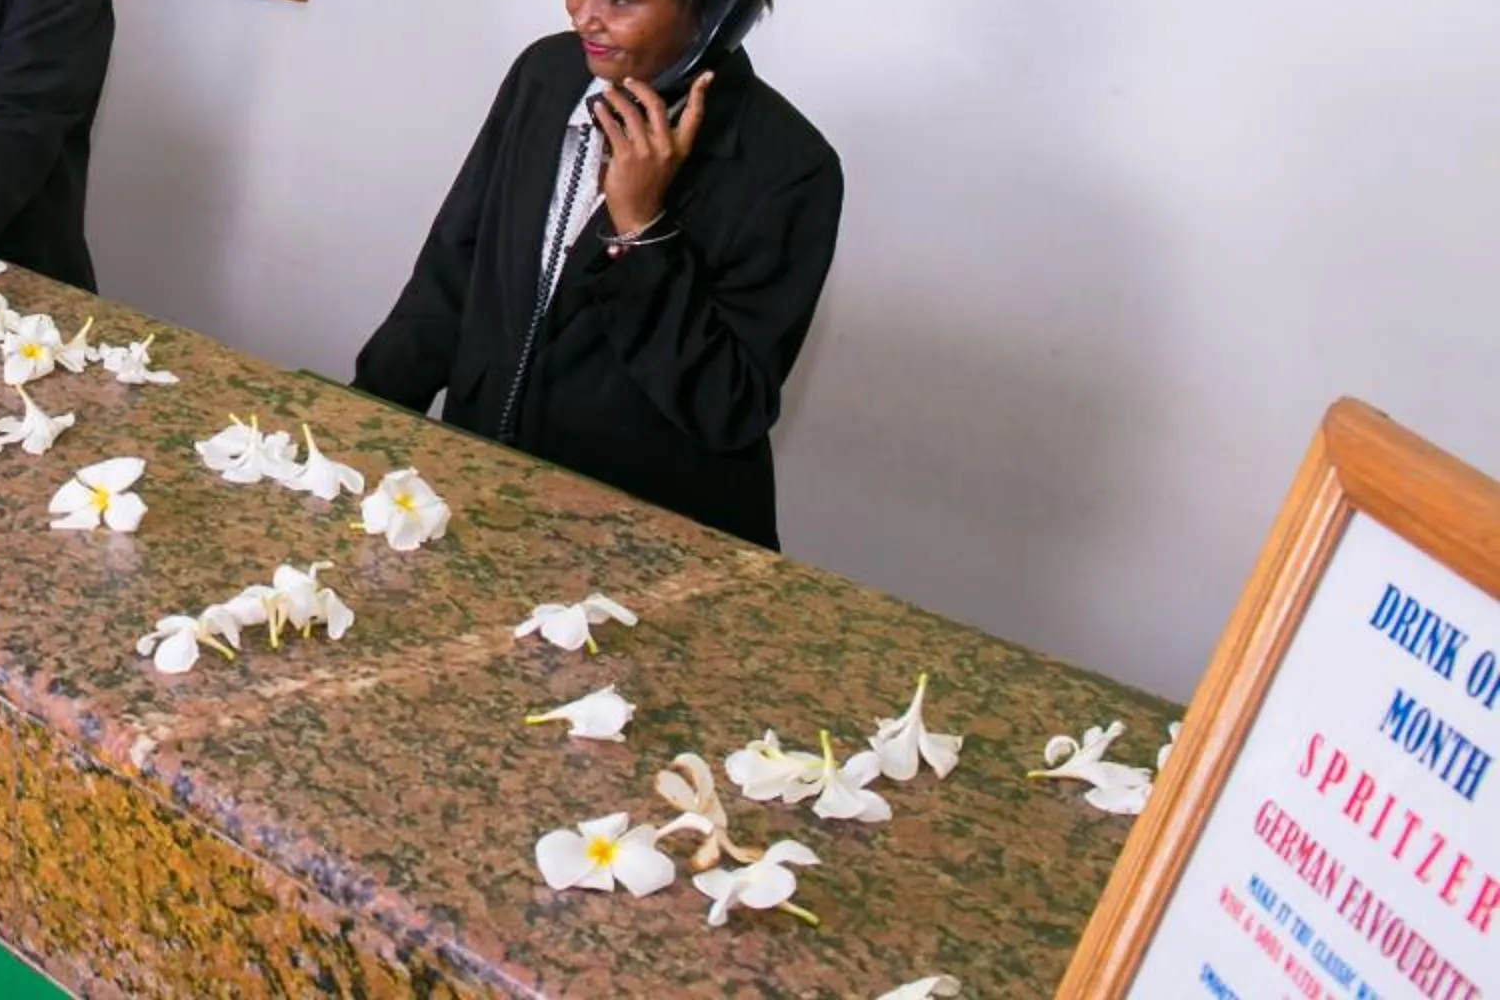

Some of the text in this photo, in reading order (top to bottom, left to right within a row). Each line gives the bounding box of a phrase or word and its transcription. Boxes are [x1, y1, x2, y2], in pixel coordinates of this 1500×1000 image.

[1369, 583, 1469, 681] DRINK
[1379, 688, 1493, 801] MONTH
[1254, 799, 1346, 900] GERMAN
[1297, 733, 1500, 932] SPRITZER
